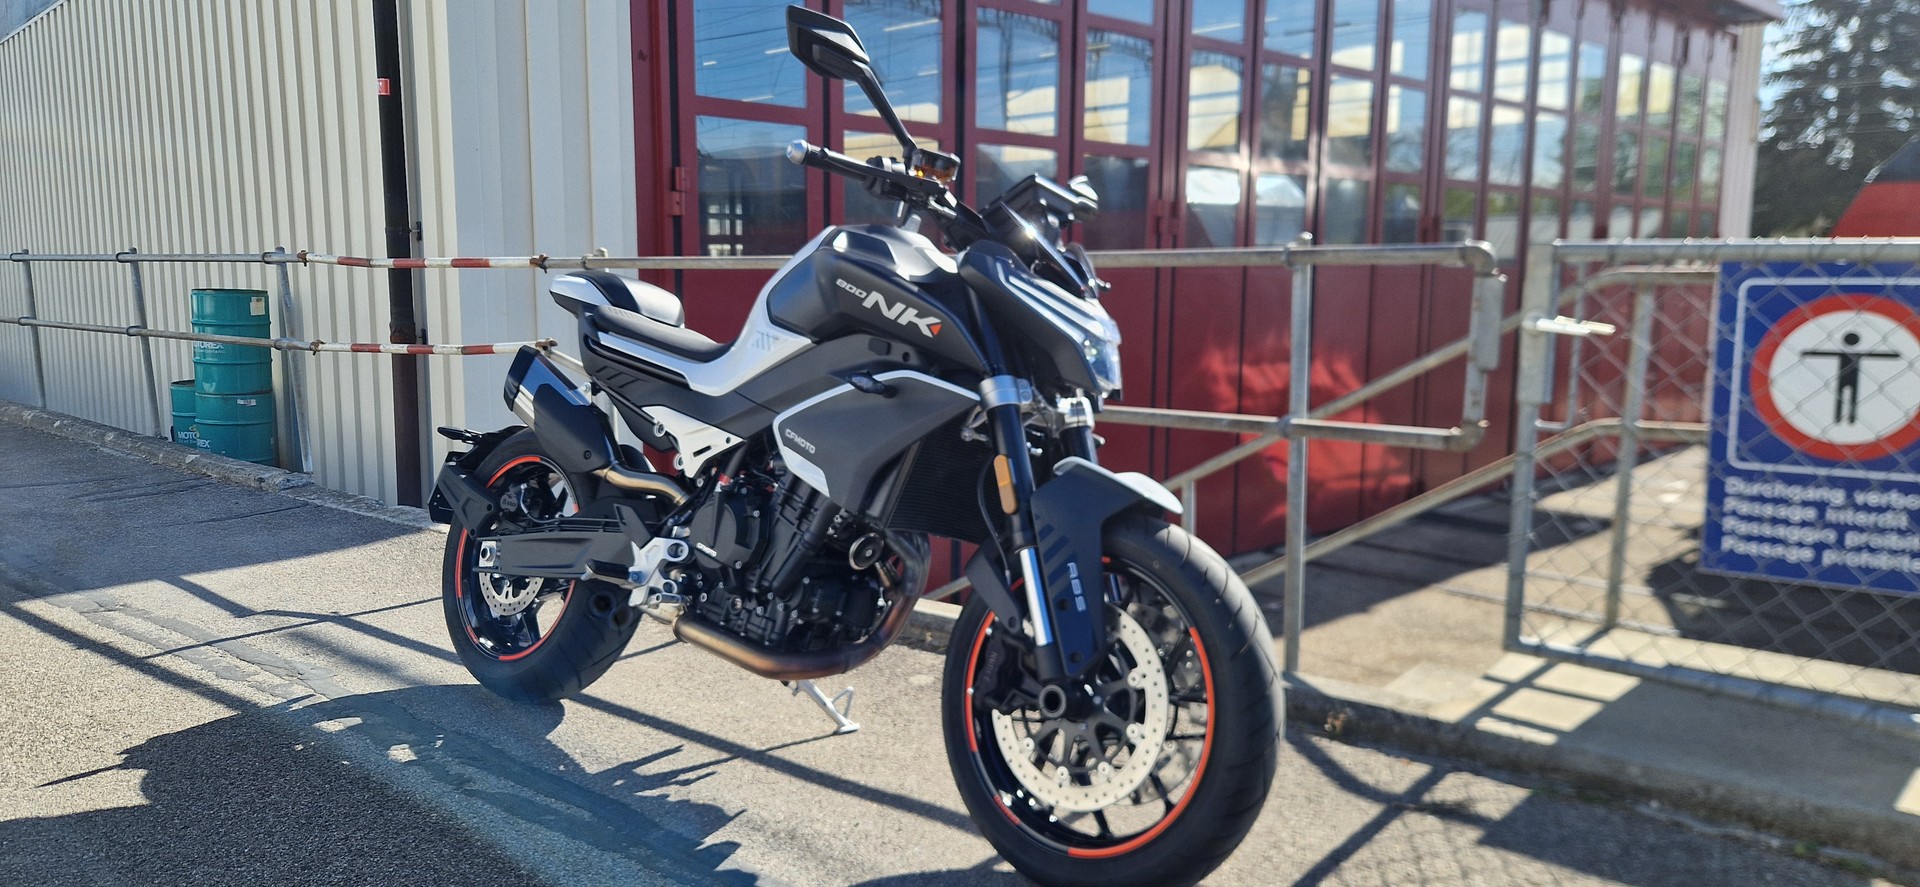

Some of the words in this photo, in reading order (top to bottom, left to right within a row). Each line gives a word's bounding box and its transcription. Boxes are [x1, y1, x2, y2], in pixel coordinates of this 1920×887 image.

[836, 278, 867, 299] 800
[862, 291, 942, 338] NK
[785, 428, 816, 454] CFMOTO
[1724, 476, 1846, 507] Durchgang
[1723, 496, 1818, 524] Passage
[1825, 506, 1910, 530] interdit
[1721, 515, 1838, 547] Passaggio
[1066, 562, 1087, 612] ABS
